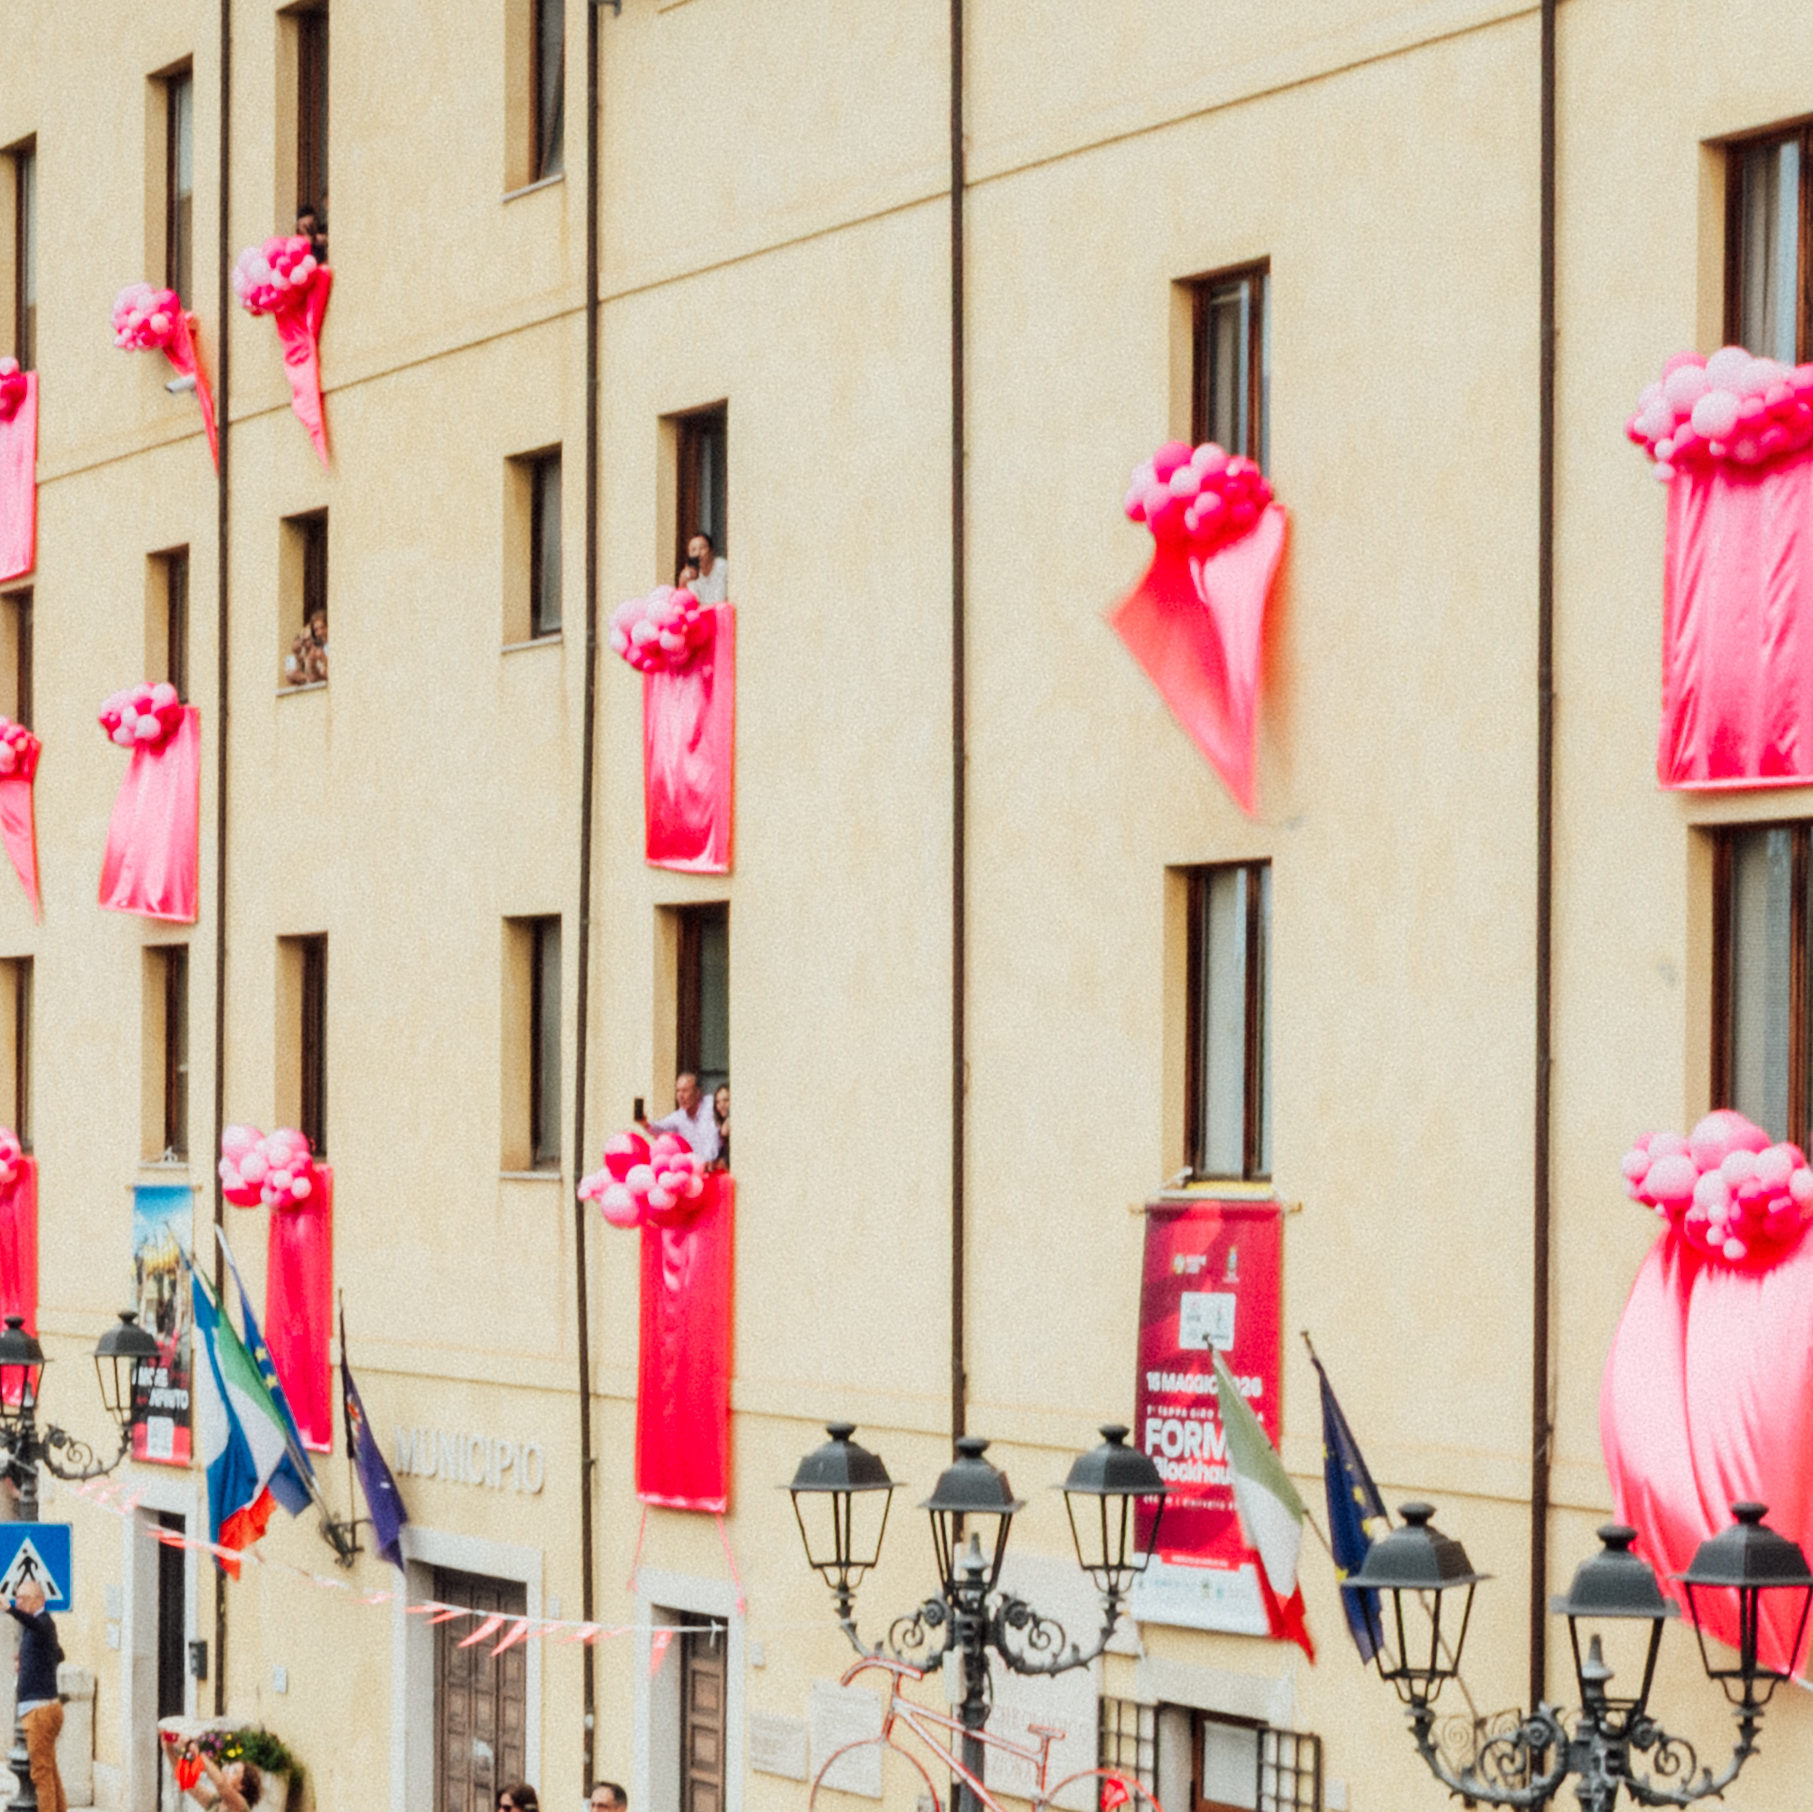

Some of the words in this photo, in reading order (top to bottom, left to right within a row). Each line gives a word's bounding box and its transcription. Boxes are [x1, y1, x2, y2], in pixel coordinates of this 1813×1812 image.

[394, 1425, 544, 1494] MUNICIPIO
[1145, 1417, 1228, 1462] FORM
[1153, 1456, 1233, 1486] Blockhau
